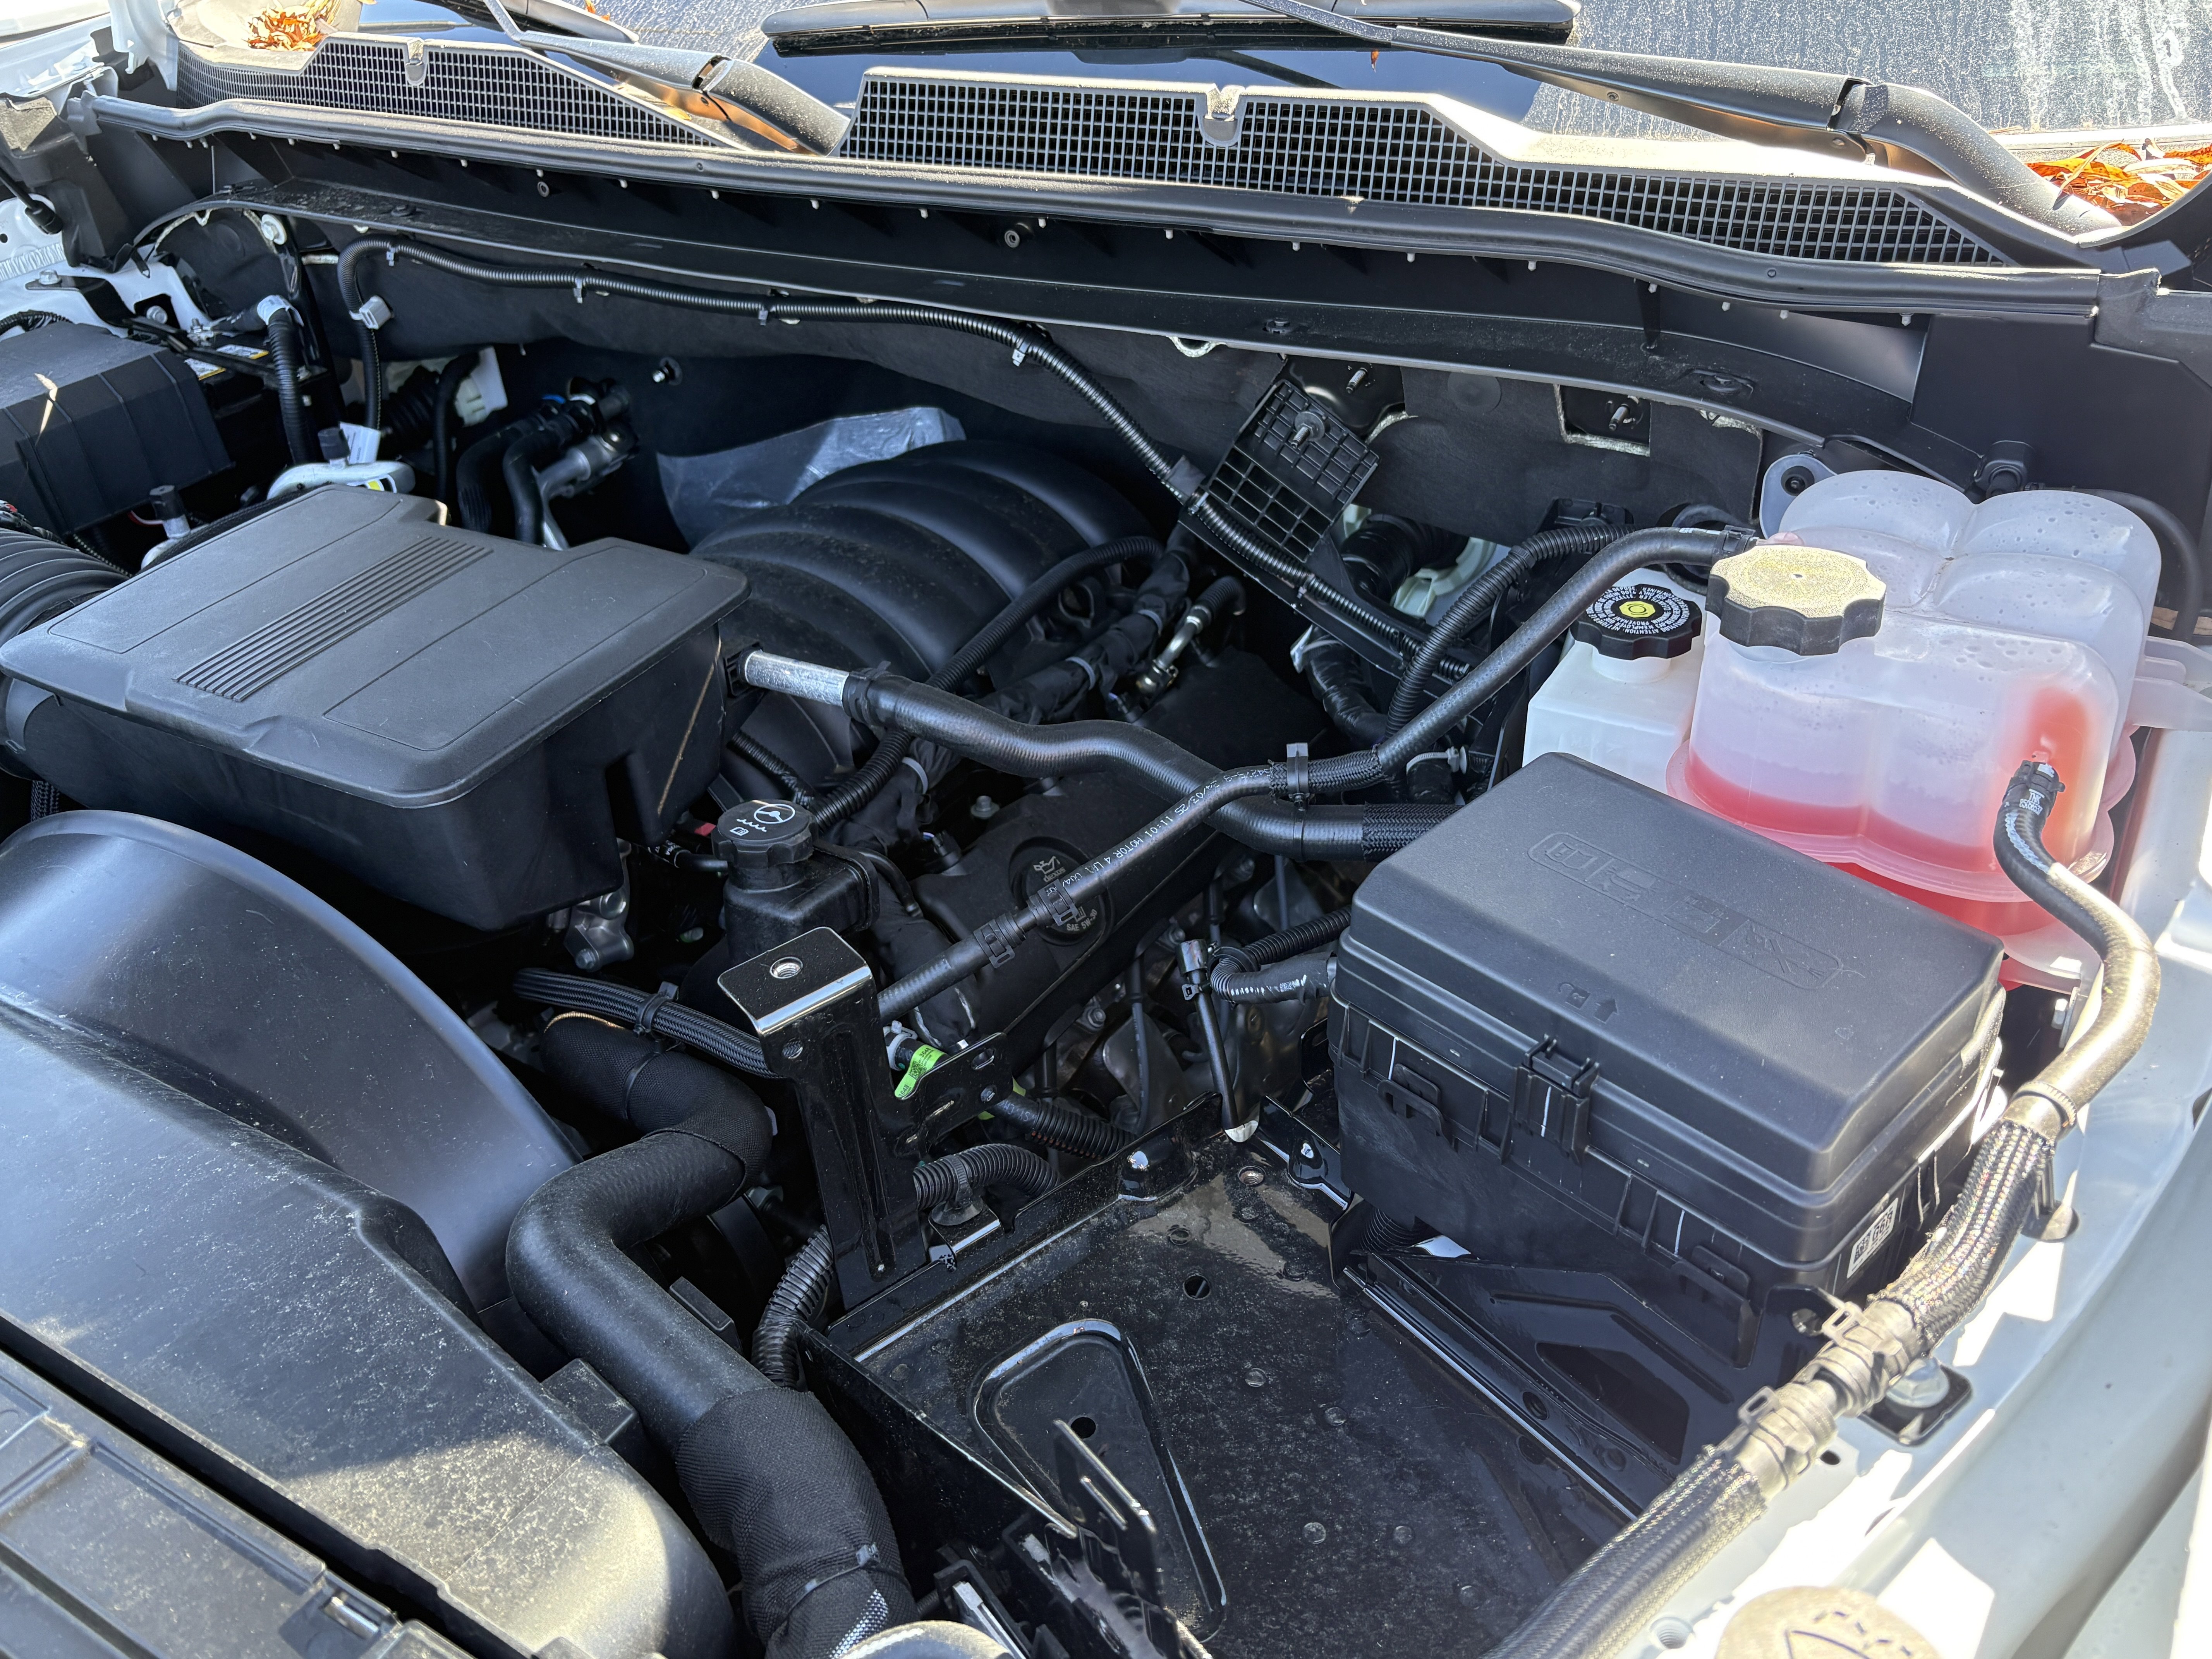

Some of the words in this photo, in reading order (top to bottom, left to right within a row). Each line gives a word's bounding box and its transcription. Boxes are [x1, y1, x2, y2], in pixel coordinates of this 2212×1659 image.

[1612, 617, 1649, 626] PROVENANT
[1614, 622, 1654, 630] N'EMPLOYER
[1175, 780, 1219, 815] 24/03/25
[1144, 816, 1173, 838] 11:01
[1114, 836, 1143, 858] MOTOR
[1043, 866, 1066, 882] dexos
[1066, 923, 1079, 931] SAE
[1080, 909, 1097, 929] 5W-30
